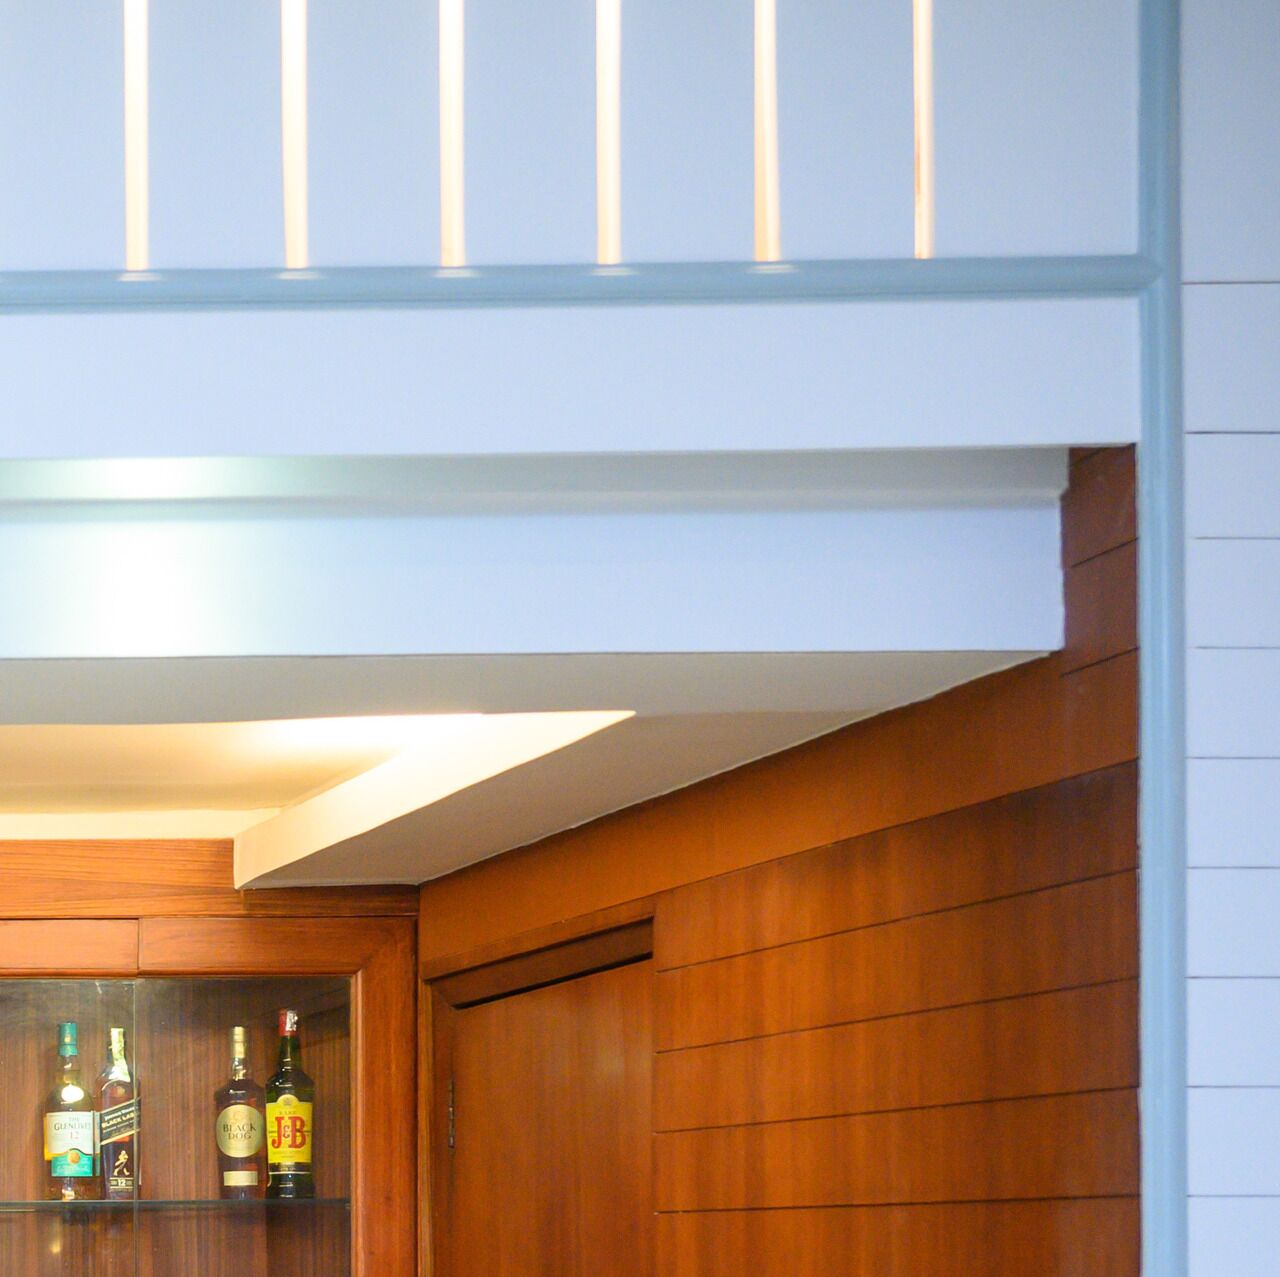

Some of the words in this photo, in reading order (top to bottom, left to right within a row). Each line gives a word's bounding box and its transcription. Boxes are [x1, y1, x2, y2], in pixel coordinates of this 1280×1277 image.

[101, 1118, 122, 1129] BLACK
[223, 1123, 257, 1133] BLACK
[228, 1131, 253, 1141] DOG
[271, 1116, 307, 1149] J&B
[117, 1179, 127, 1187] 12
